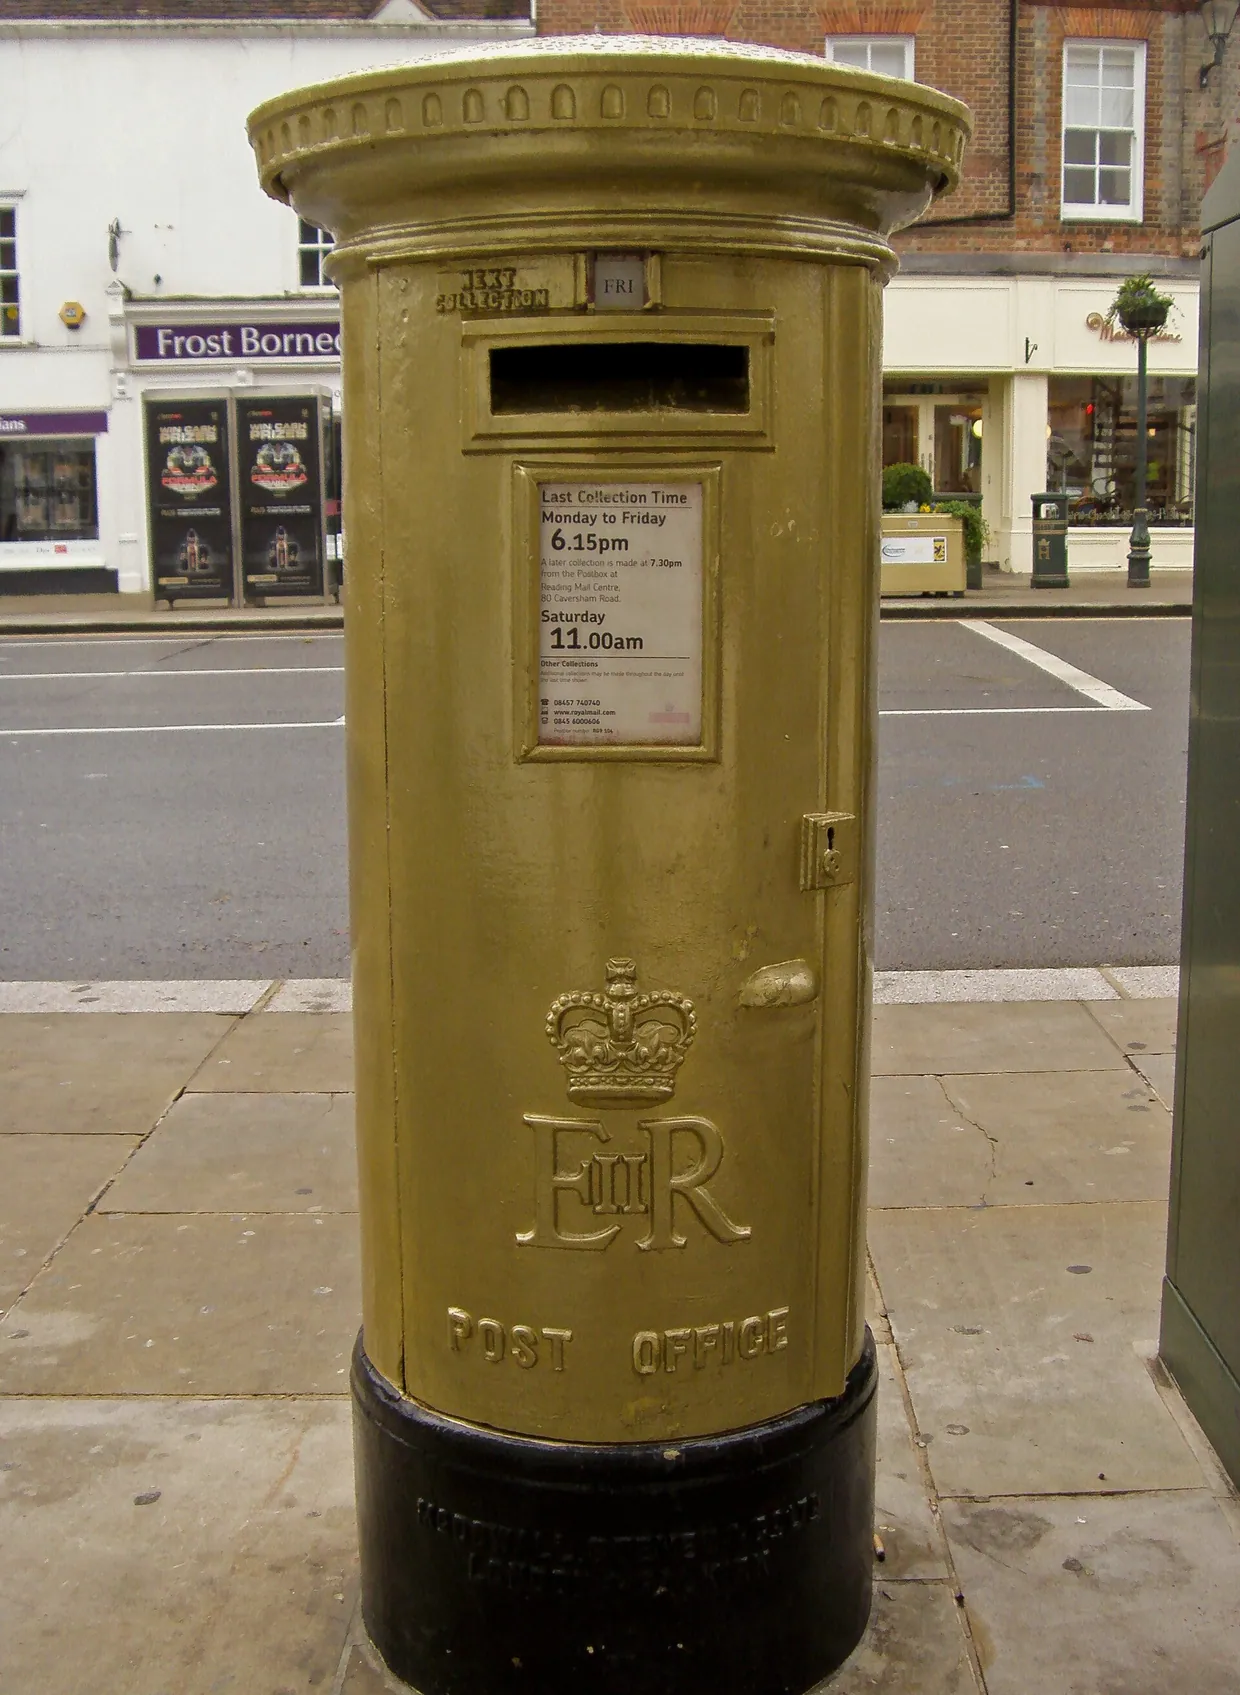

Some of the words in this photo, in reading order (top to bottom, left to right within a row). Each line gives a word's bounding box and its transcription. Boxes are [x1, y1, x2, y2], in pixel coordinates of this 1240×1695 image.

[603, 279, 633, 294] FRI
[157, 328, 232, 356] Frost
[159, 432, 218, 444] PRIZES
[249, 429, 308, 440] PRIZES
[541, 490, 573, 504] Last
[578, 490, 647, 504] Collection
[651, 490, 688, 504] Time
[541, 511, 598, 527] Monday
[602, 512, 617, 524] to
[622, 511, 667, 527] Friday
[551, 528, 629, 554] 6.15pm
[548, 558, 566, 567] later
[568, 558, 605, 567] collection
[606, 558, 614, 567] is
[615, 558, 638, 567] made
[639, 559, 649, 567] at
[650, 558, 682, 569] 7.30pm
[541, 570, 560, 578] from
[561, 570, 575, 578] the
[576, 570, 608, 578] Postbox
[541, 583, 572, 593] Reading
[574, 583, 591, 592] Mail
[553, 594, 597, 603] Caversham
[541, 609, 606, 625] Saturday
[550, 627, 644, 650] 11.00am
[540, 660, 560, 668] Other
[561, 660, 599, 668] Collections
[553, 709, 616, 717] www.royalmail.com
[446, 1305, 573, 1372] POST
[631, 1304, 790, 1375] OFFICE
